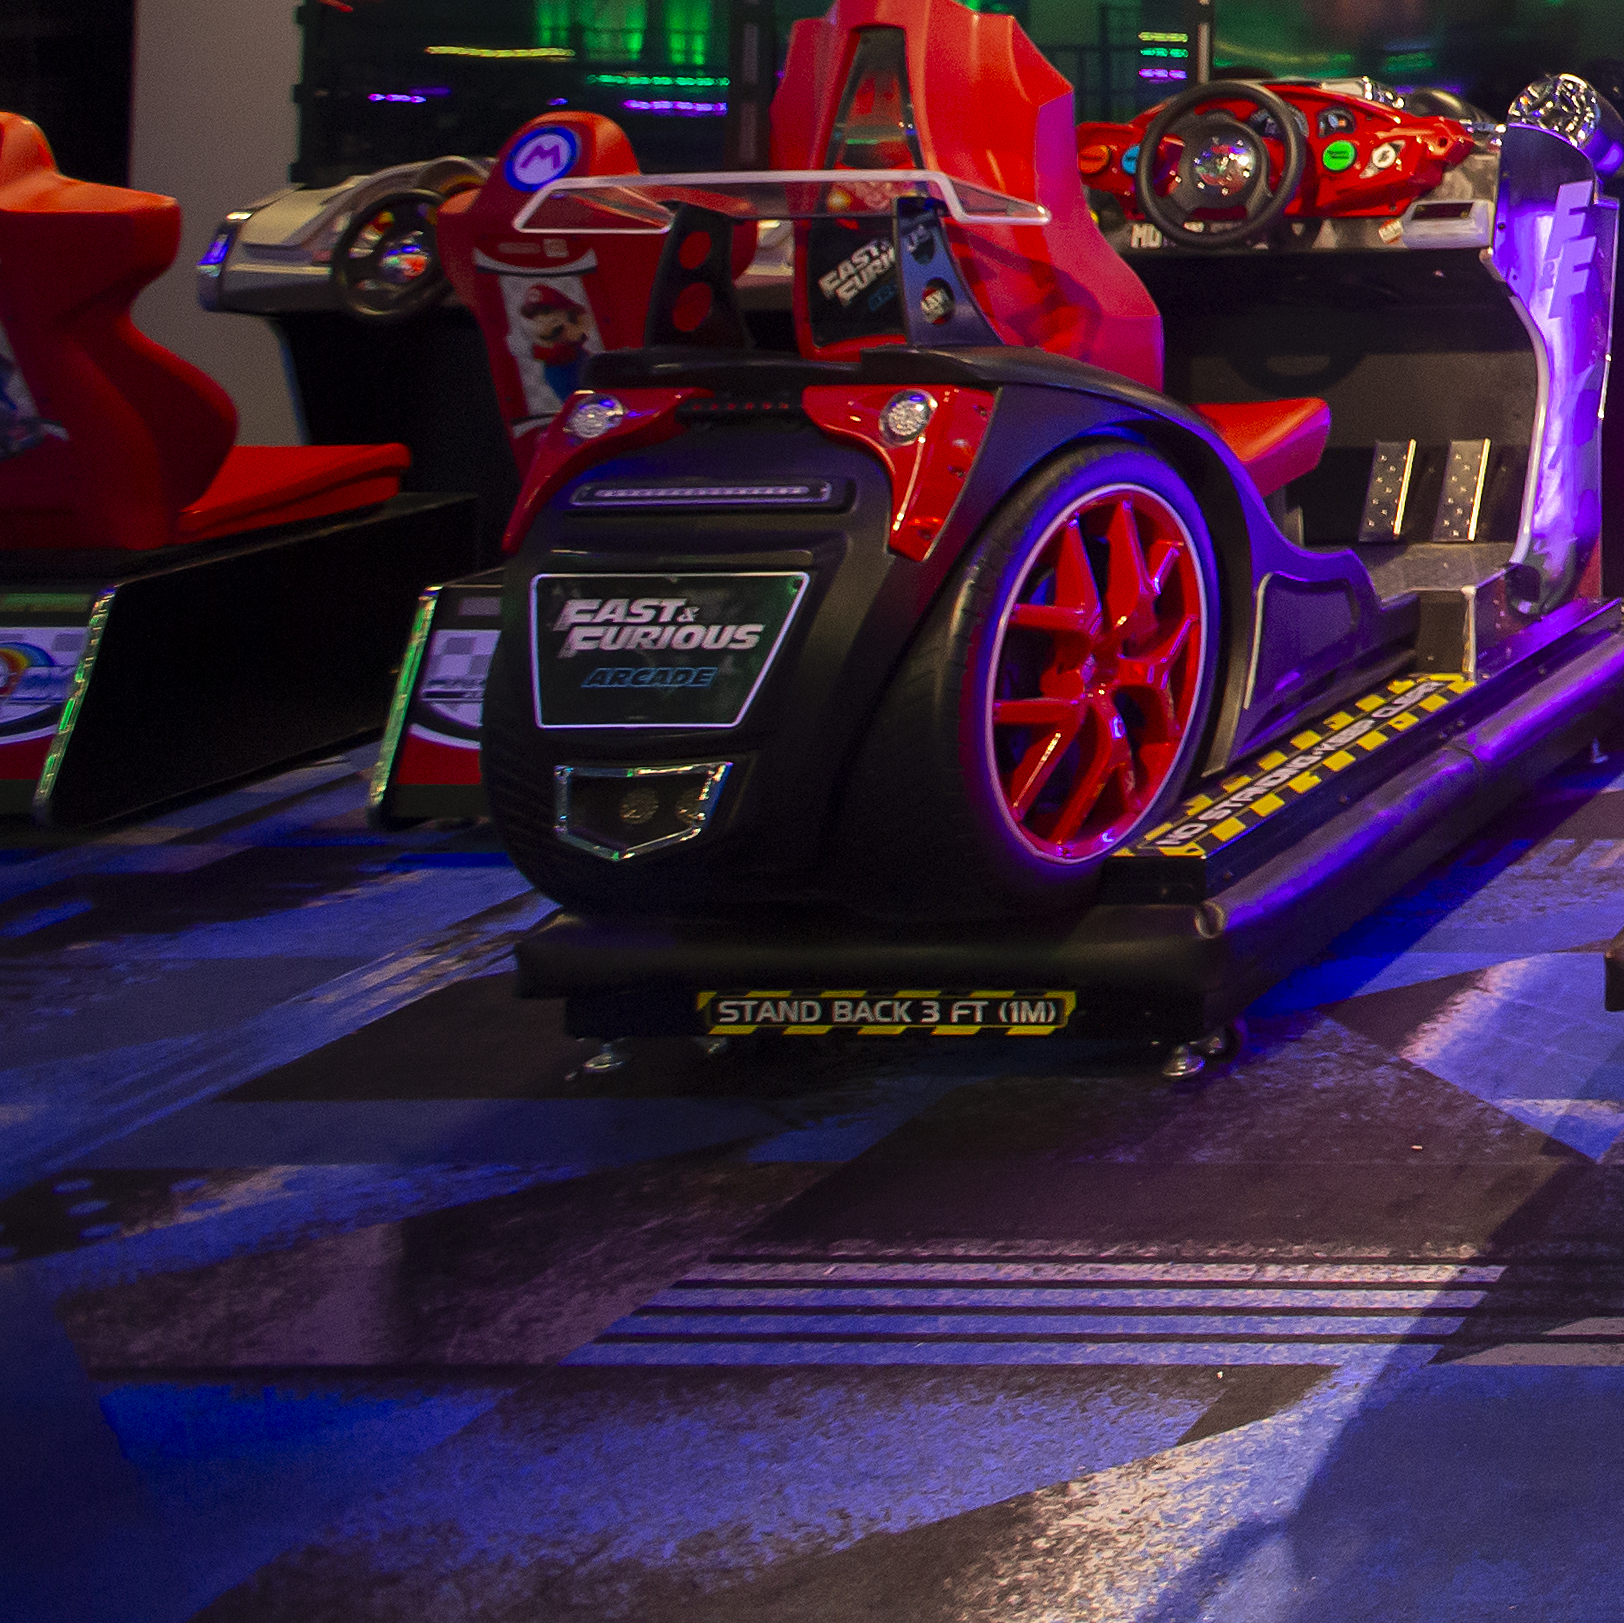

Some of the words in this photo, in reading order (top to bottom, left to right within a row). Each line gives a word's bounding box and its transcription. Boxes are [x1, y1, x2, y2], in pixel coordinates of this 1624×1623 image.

[552, 598, 688, 631] FAST
[557, 623, 766, 658] FURIOUS
[580, 666, 718, 688] ARCADE
[719, 1001, 822, 1023] STAND
[832, 1001, 912, 1023] BACK
[920, 1001, 940, 1023] 3
[950, 1001, 989, 1022] FT
[998, 1000, 1057, 1023] (1M)
